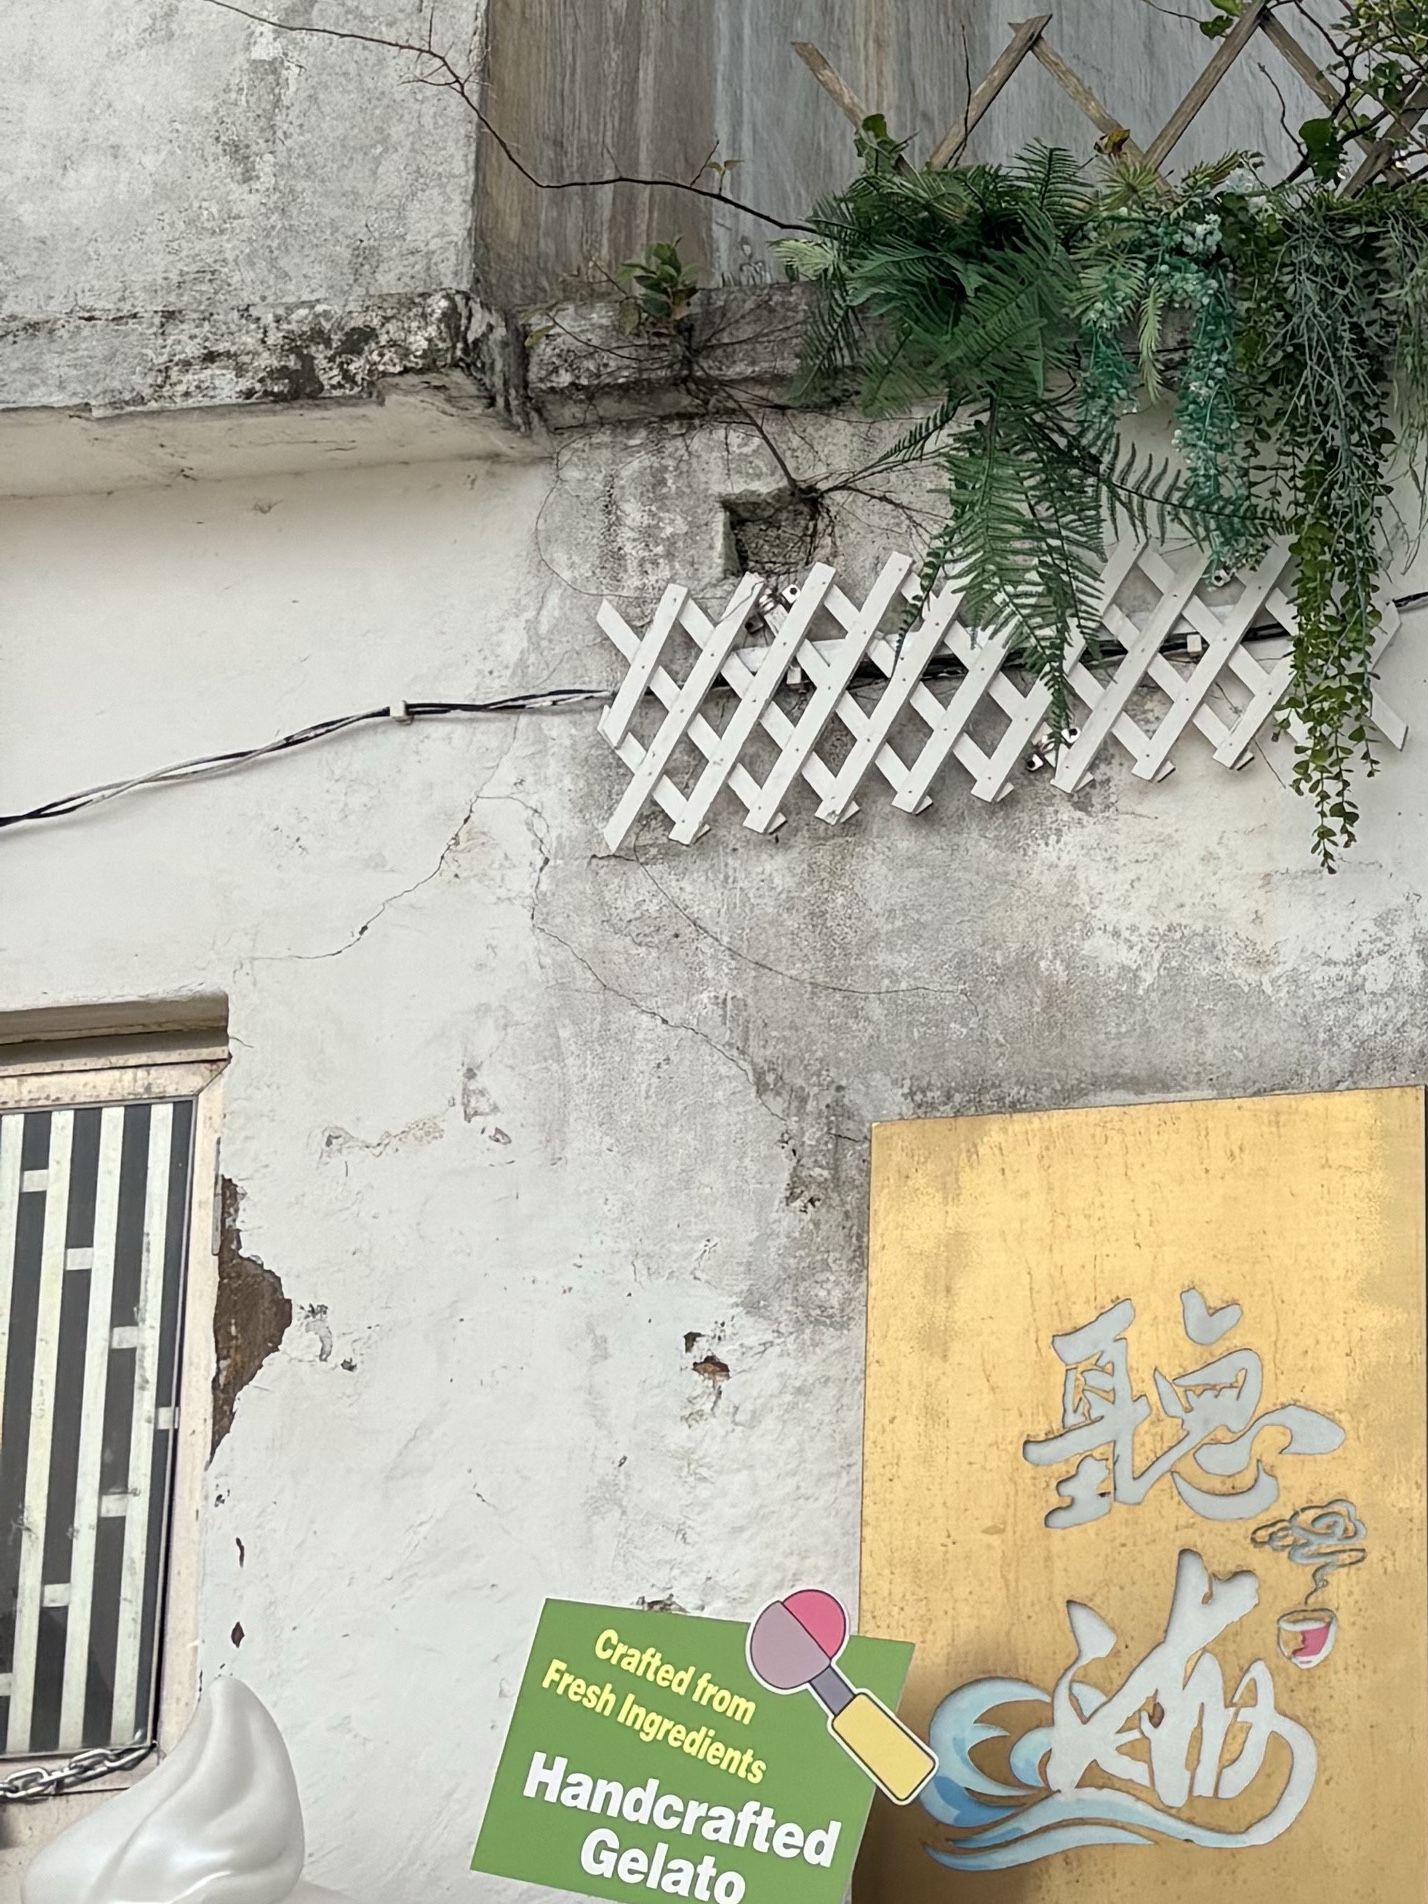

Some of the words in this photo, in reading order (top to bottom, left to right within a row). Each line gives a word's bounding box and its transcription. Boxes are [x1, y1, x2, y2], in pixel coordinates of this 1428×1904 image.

[541, 1658, 617, 1717] Fresh
[616, 1693, 769, 1785] Ingredients
[594, 1628, 696, 1696] Crafted
[690, 1672, 757, 1726] from
[522, 1751, 843, 1869] Handcrafted
